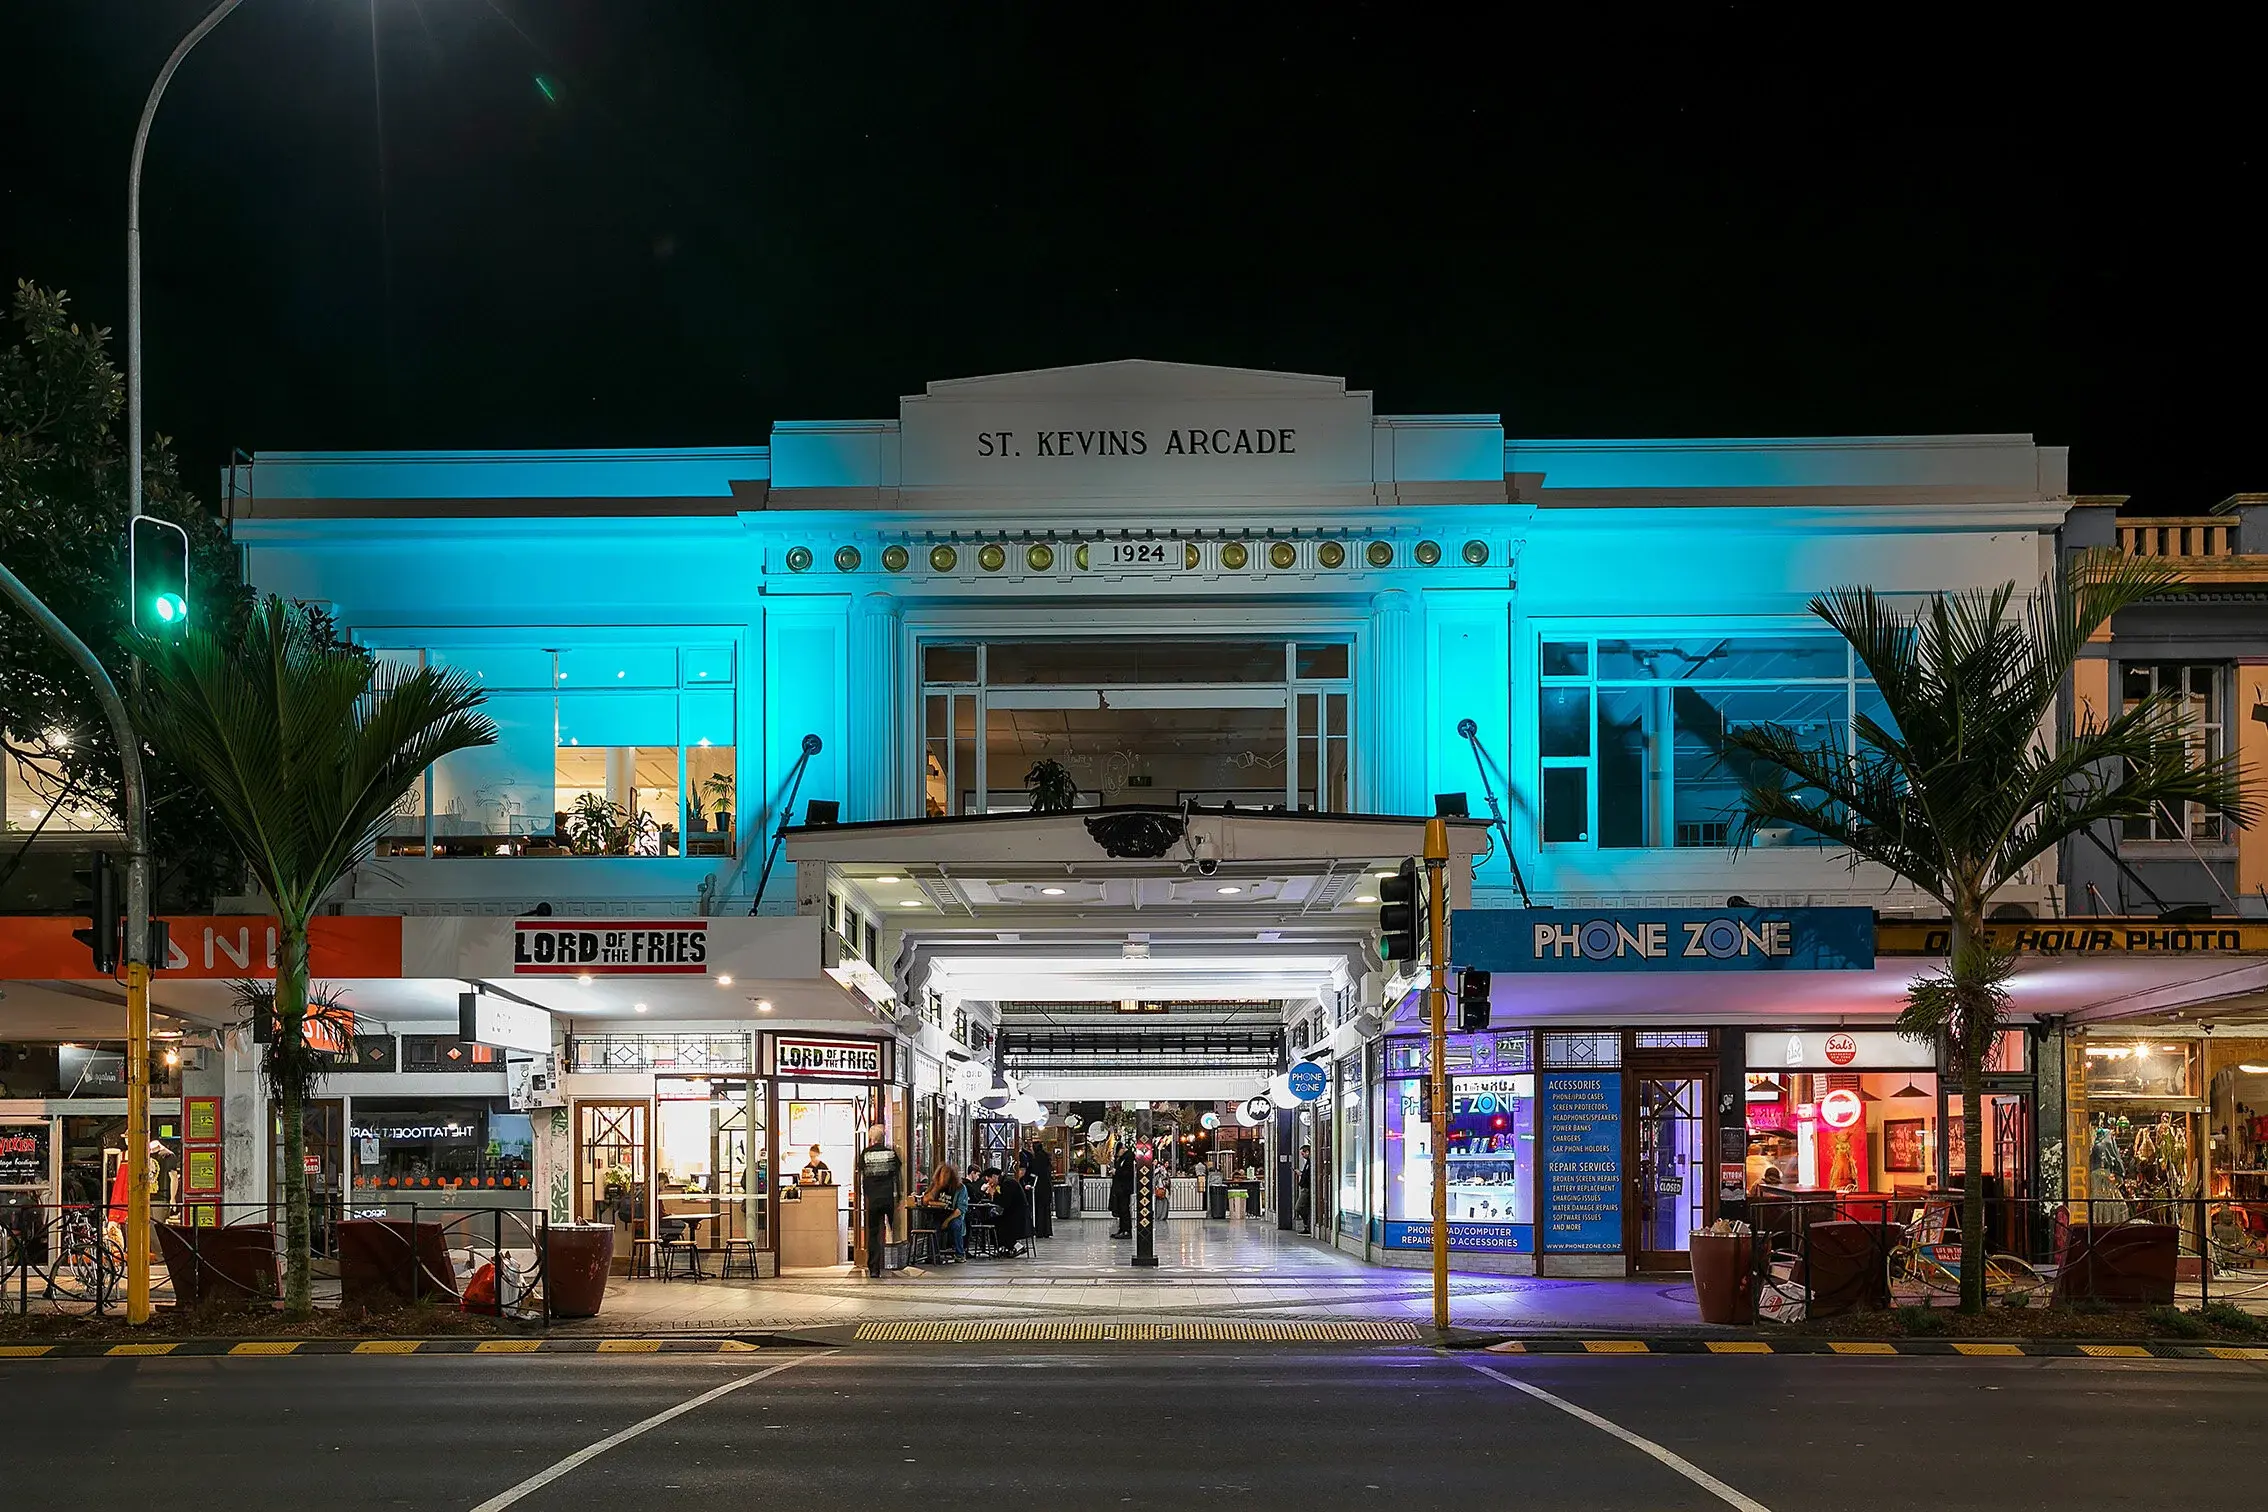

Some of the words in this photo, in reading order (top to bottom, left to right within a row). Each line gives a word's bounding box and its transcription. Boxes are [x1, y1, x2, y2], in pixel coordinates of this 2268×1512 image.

[977, 431, 1020, 457] ST.
[1037, 430, 1148, 457] KEVINS
[1164, 428, 1296, 456] ARCADE
[1113, 544, 1165, 562] 1924
[605, 932, 627, 948] OF
[1533, 917, 1668, 961] PHONE
[1681, 916, 1792, 959] ZONE
[2015, 930, 2114, 951] HOUR
[2126, 930, 2241, 951] PHOTO
[515, 932, 599, 963] LORD
[631, 931, 707, 963] FRIES
[601, 948, 629, 963] THE
[1829, 1039, 1853, 1050] Sal's
[780, 1046, 823, 1067] LORD
[826, 1049, 837, 1059] OF
[824, 1059, 838, 1068] THE
[840, 1050, 877, 1071] FRIES
[1292, 1073, 1323, 1081] PHONE
[1295, 1083, 1320, 1092] ZONE
[1433, 1086, 1440, 1095] 2
[1548, 1080, 1601, 1090] ACCESSORIES
[1400, 1095, 1462, 1116] PHE
[1468, 1092, 1521, 1115] ZONE
[1552, 1103, 1573, 1111] SCREEN
[1574, 1103, 1609, 1111] PROTECTORS
[1549, 1162, 1577, 1172] REPAIR
[1579, 1162, 1616, 1172] SERVICES
[1552, 1184, 1576, 1192] BATTERY
[1577, 1184, 1616, 1192] REPLACEMENT
[1660, 1182, 1681, 1192] CLOSED
[1552, 1213, 1581, 1221] SOFTWARE
[1582, 1213, 1602, 1221] ISSUES
[1407, 1225, 1512, 1237] PHONEPAD/COMPUTER
[1458, 1237, 1518, 1247] ACCESSORIES
